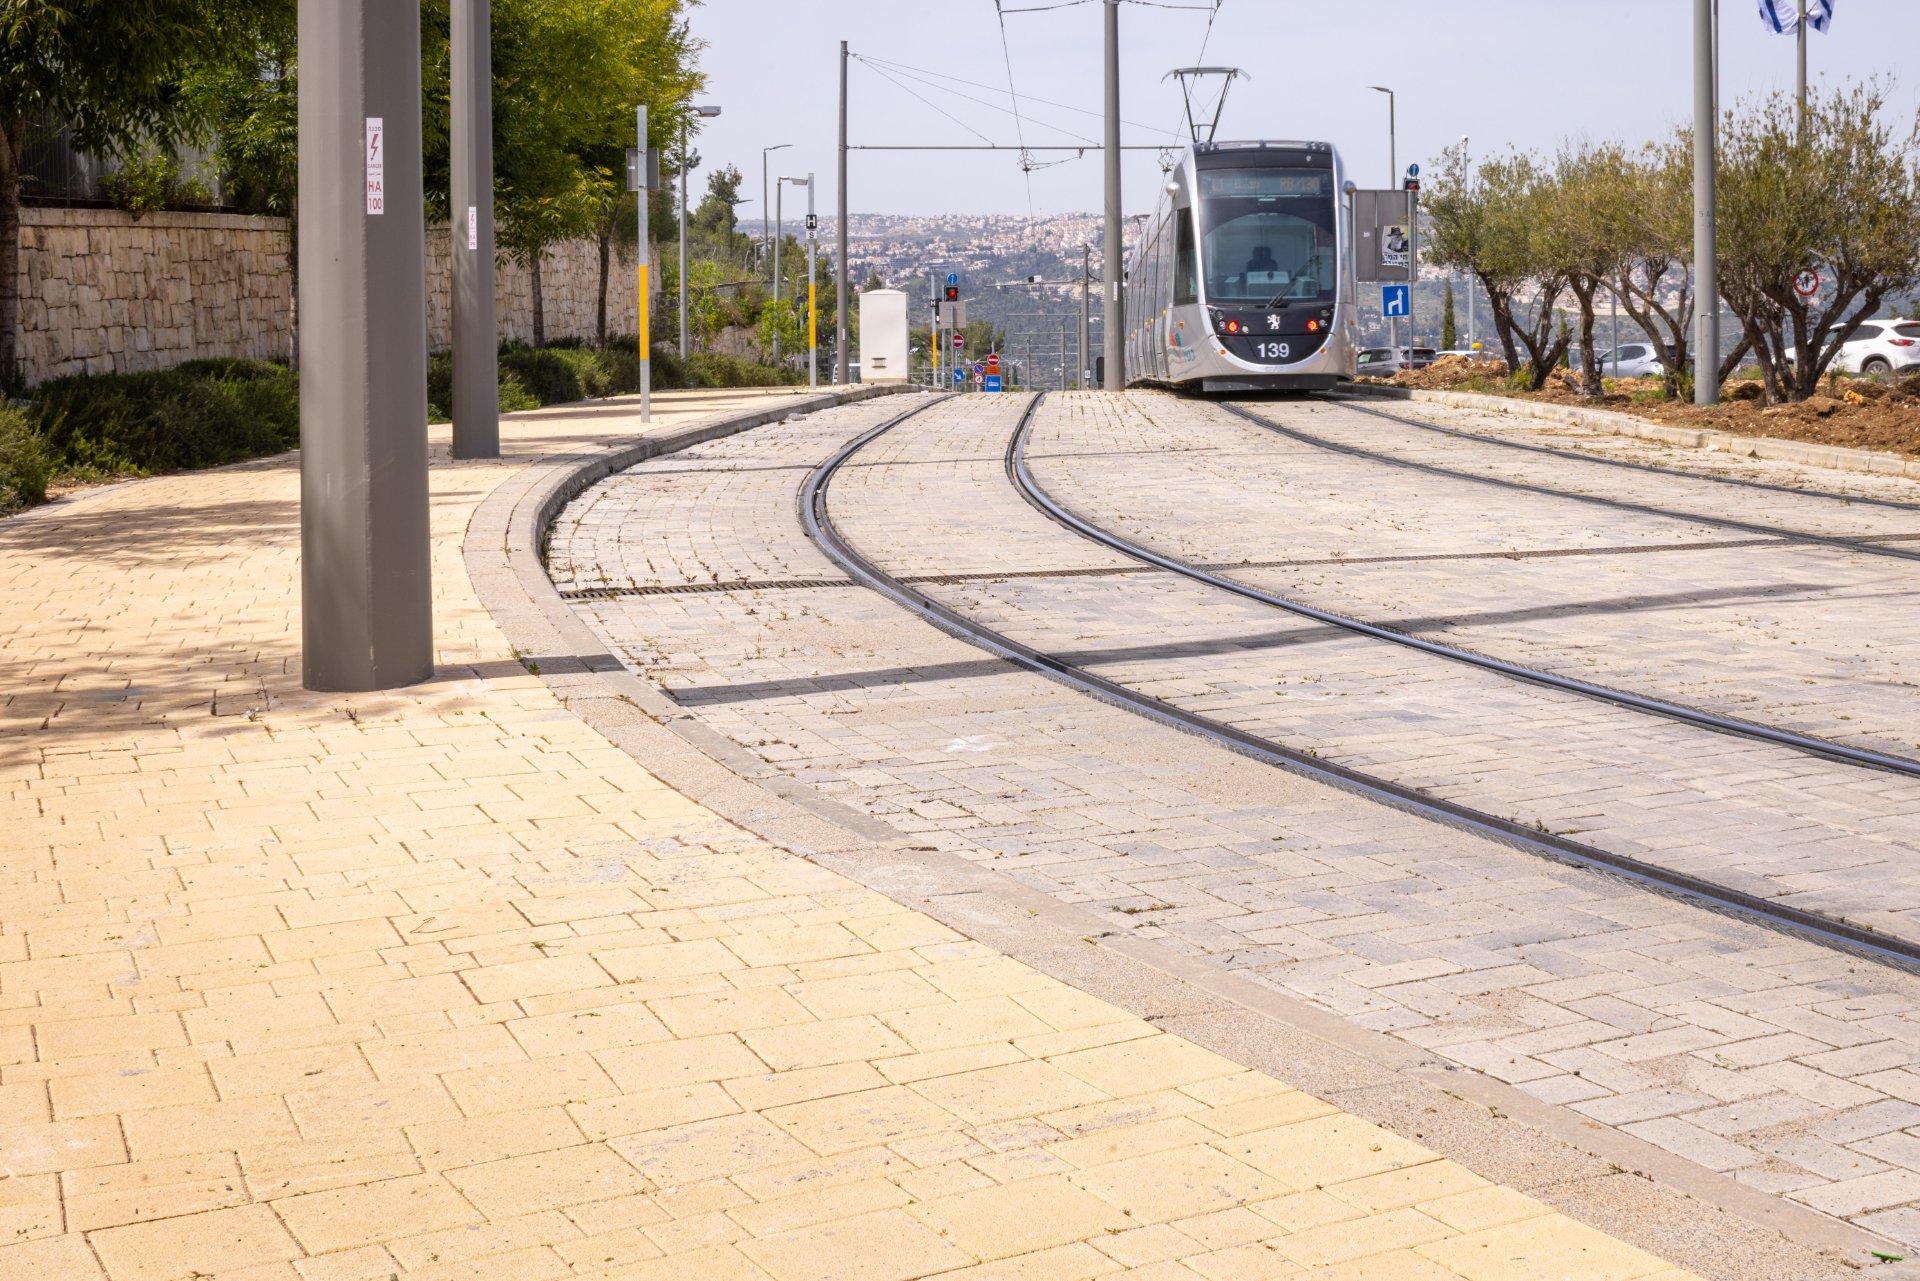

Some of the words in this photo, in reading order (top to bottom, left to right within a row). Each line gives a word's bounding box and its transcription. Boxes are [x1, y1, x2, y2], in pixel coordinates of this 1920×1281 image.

[368, 181, 382, 192] HA
[369, 198, 382, 210] 100
[807, 216, 816, 227] H
[1257, 343, 1290, 358] 139
